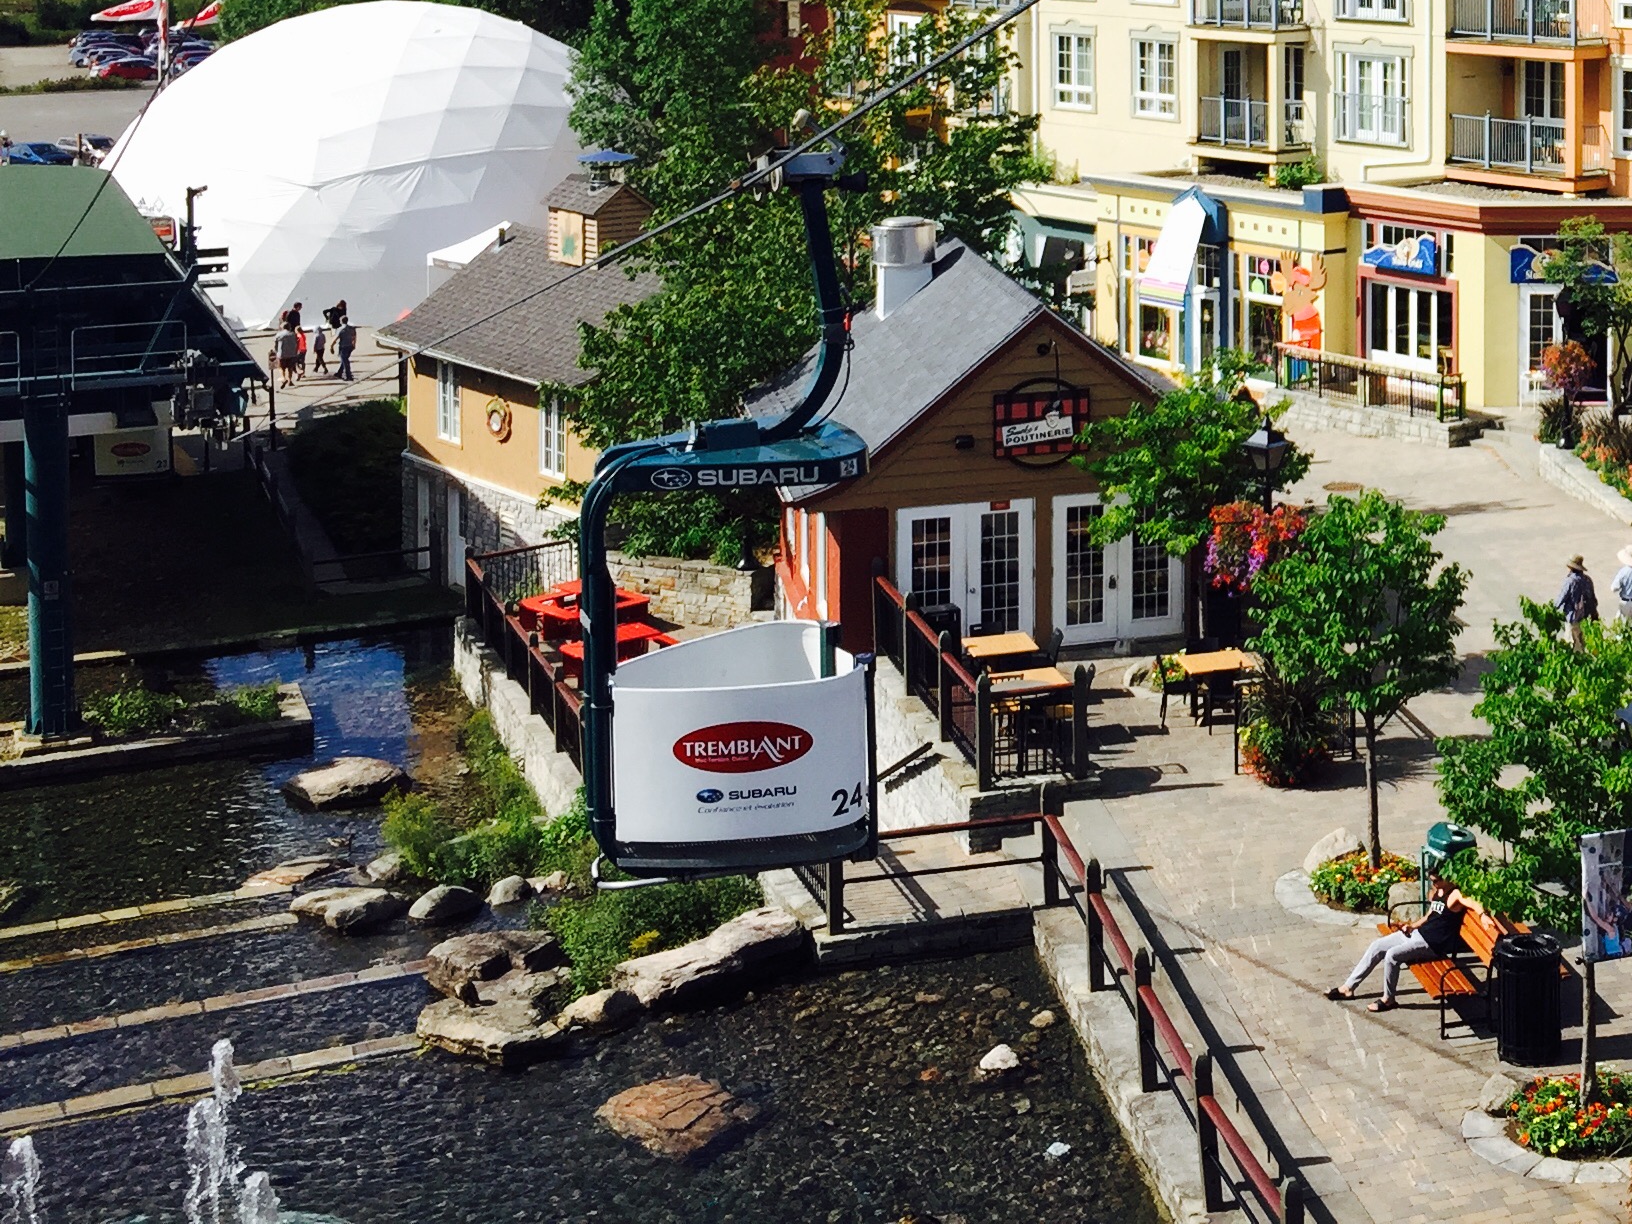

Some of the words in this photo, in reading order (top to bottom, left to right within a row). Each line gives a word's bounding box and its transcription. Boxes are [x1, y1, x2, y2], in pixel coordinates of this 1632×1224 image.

[1005, 427, 1072, 445] POUTINERIE
[843, 460, 855, 471] 24
[697, 466, 819, 486] SUBARU
[682, 735, 803, 763] TREMBLANT
[728, 786, 797, 800] SUBARU
[831, 781, 863, 817] 24
